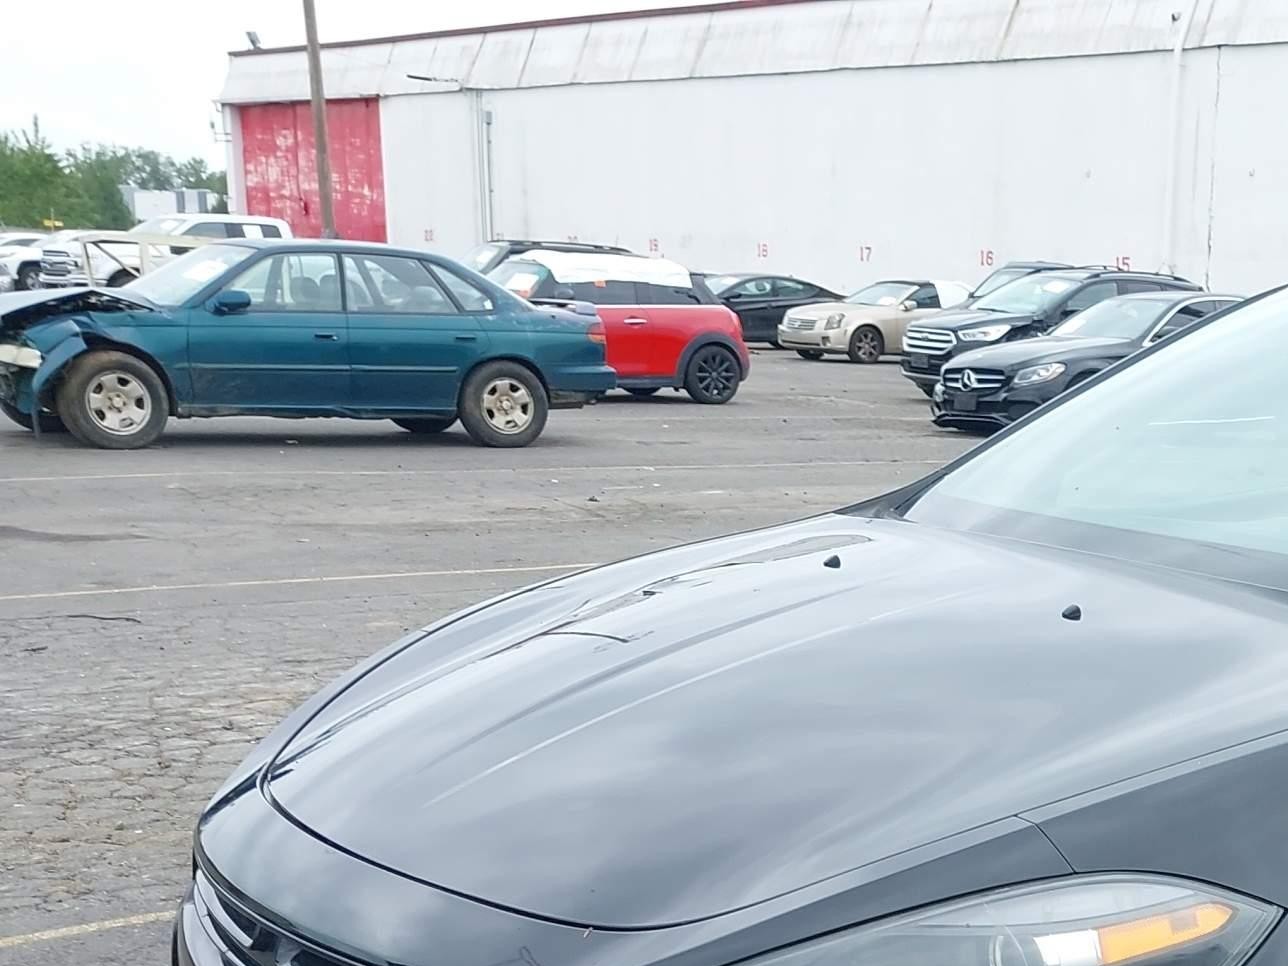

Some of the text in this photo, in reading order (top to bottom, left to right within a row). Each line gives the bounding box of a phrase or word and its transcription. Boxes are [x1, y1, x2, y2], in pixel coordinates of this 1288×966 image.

[859, 246, 872, 262] 17
[980, 249, 994, 266] 16
[1116, 256, 1131, 271] 15
